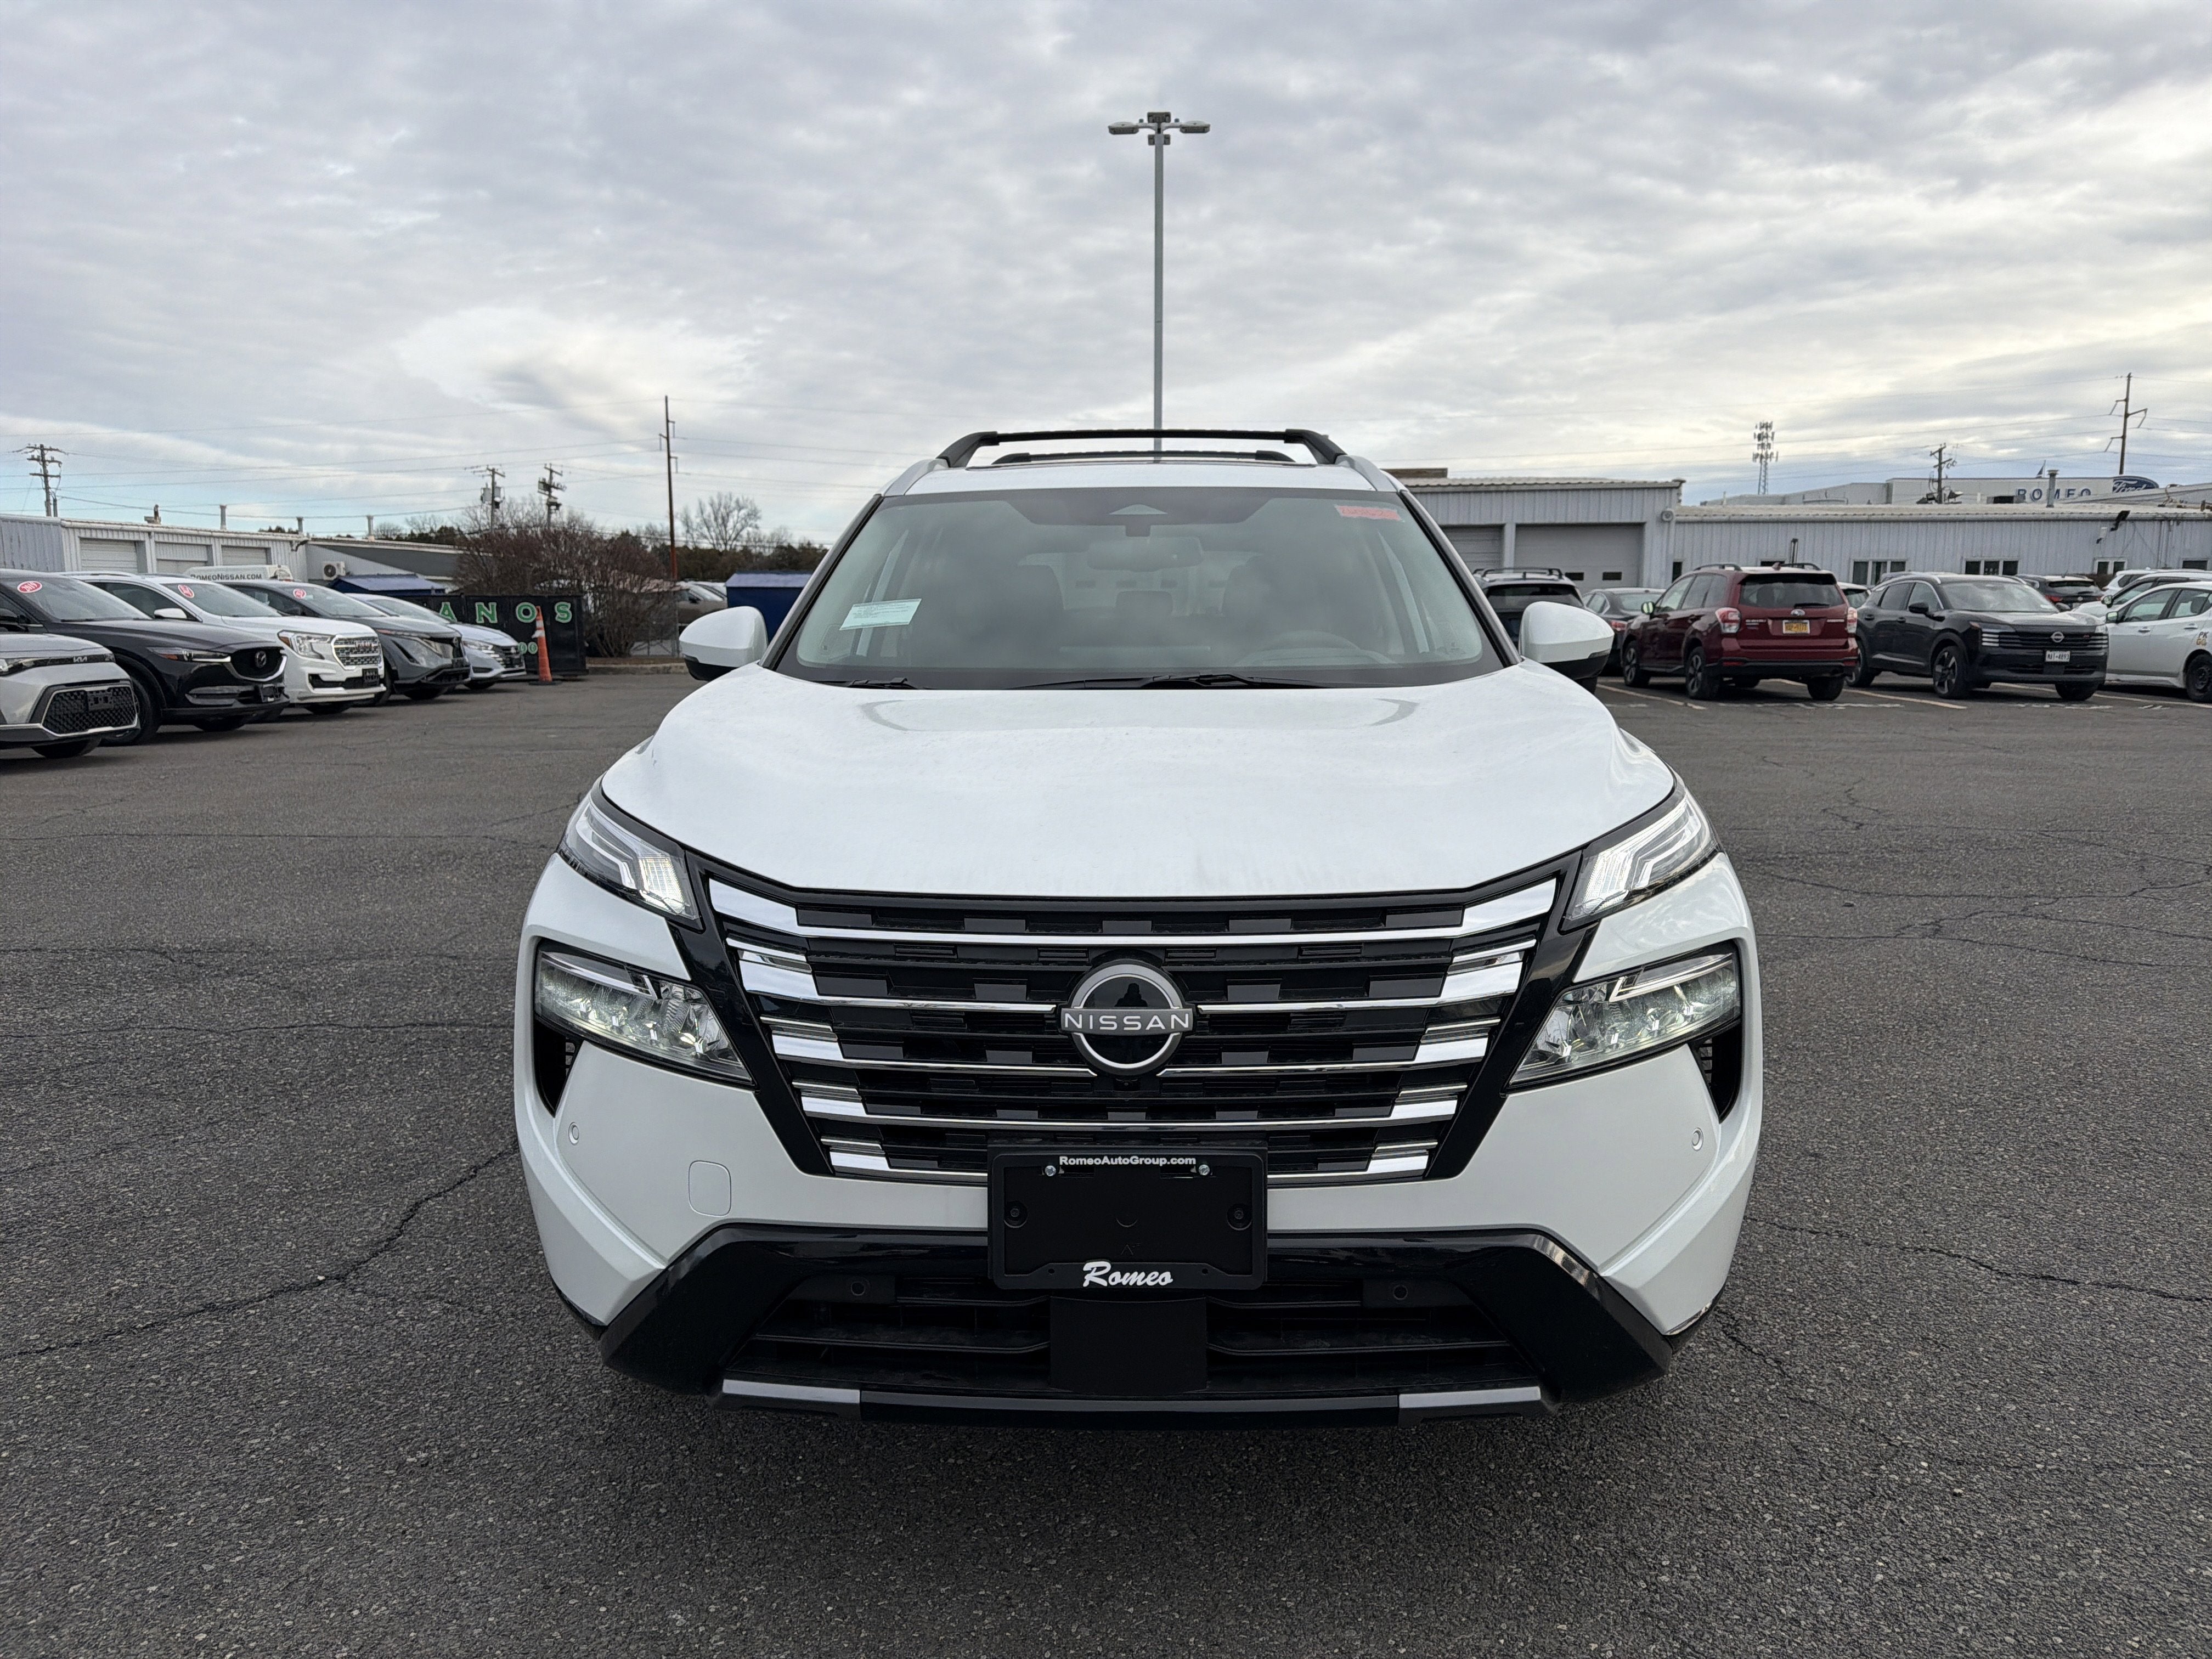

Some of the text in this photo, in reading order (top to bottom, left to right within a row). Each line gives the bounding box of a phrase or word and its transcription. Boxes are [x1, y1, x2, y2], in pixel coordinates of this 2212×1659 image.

[1064, 1013, 1189, 1030] NISSAN
[1059, 1155, 1197, 1166] RomeoAutoGroup.com
[1082, 1261, 1173, 1288] Romeo
